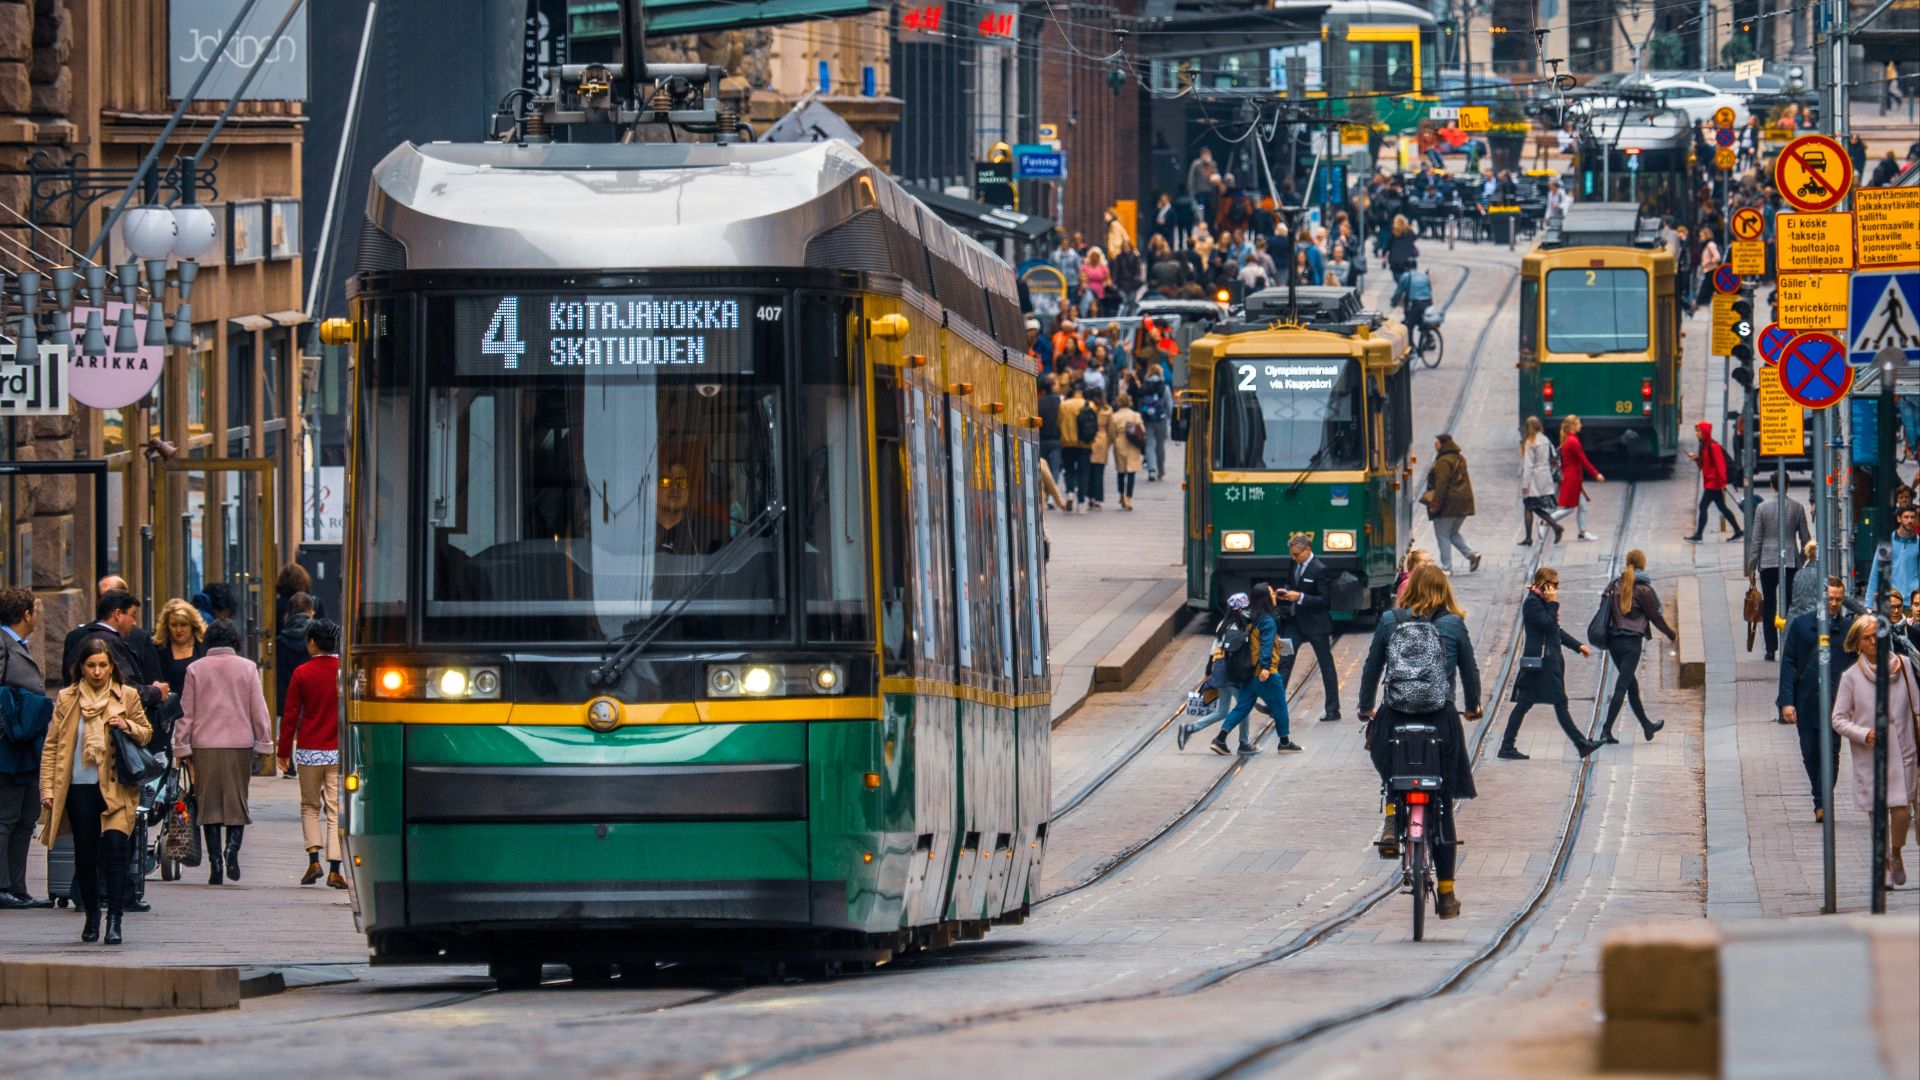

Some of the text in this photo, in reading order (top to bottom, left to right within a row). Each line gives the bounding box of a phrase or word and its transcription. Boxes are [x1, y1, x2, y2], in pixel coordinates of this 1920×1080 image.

[526, 17, 536, 111] GLLERIA
[1787, 219, 1796, 228] Ei
[1859, 212, 1888, 221] sallittu
[1584, 270, 1597, 286] 2
[1780, 278, 1821, 289] Gäller ej
[550, 300, 740, 330] KATAJANOKKA
[756, 306, 782, 322] 407
[1781, 302, 1847, 313] -servicekörnin
[481, 296, 526, 369] 4
[550, 336, 705, 365] SKATUDDEN
[68, 356, 149, 371] ARIKKA
[1238, 364, 1257, 391] 2
[1269, 378, 1333, 391] via Kauppatori
[1615, 400, 1633, 413] 89
